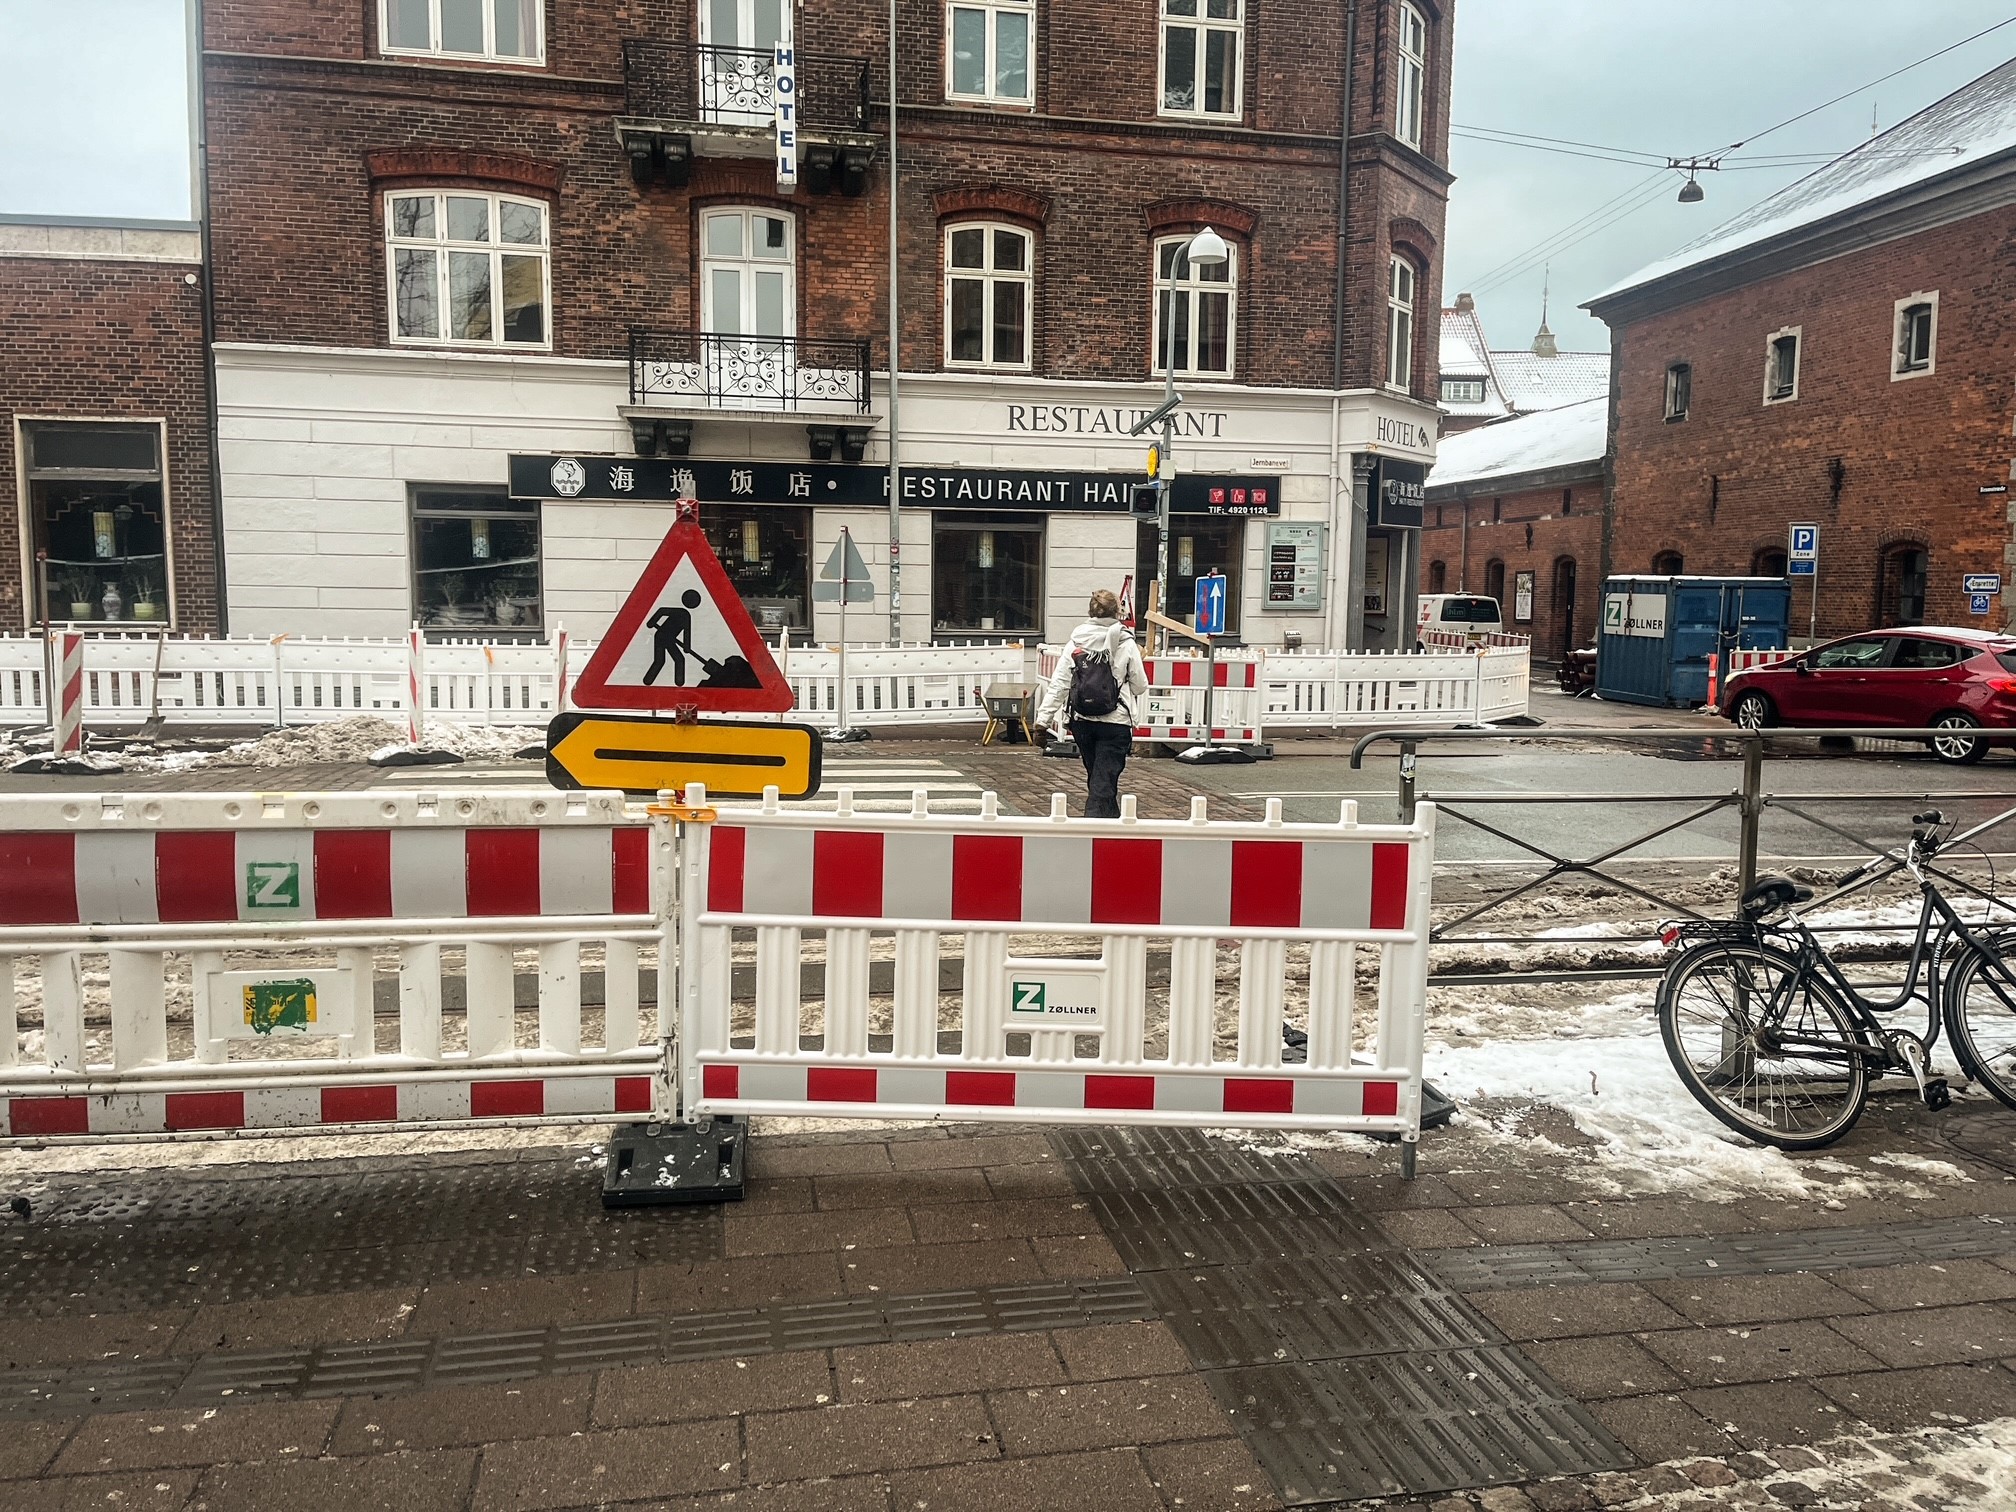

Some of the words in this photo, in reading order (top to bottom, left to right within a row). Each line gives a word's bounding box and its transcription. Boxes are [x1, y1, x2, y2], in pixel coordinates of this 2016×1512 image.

[776, 49, 794, 175] HOTEL
[1006, 404, 1228, 438] RESTAURANT
[1376, 415, 1417, 448] HOTEL
[1228, 506, 1248, 514] 4920
[1249, 506, 1268, 514] 1126
[1798, 530, 1811, 549] P
[1607, 602, 1620, 625] Z
[250, 864, 297, 905] Z
[1014, 983, 1043, 1011] Z
[1048, 1005, 1097, 1015] ZØLLNER
